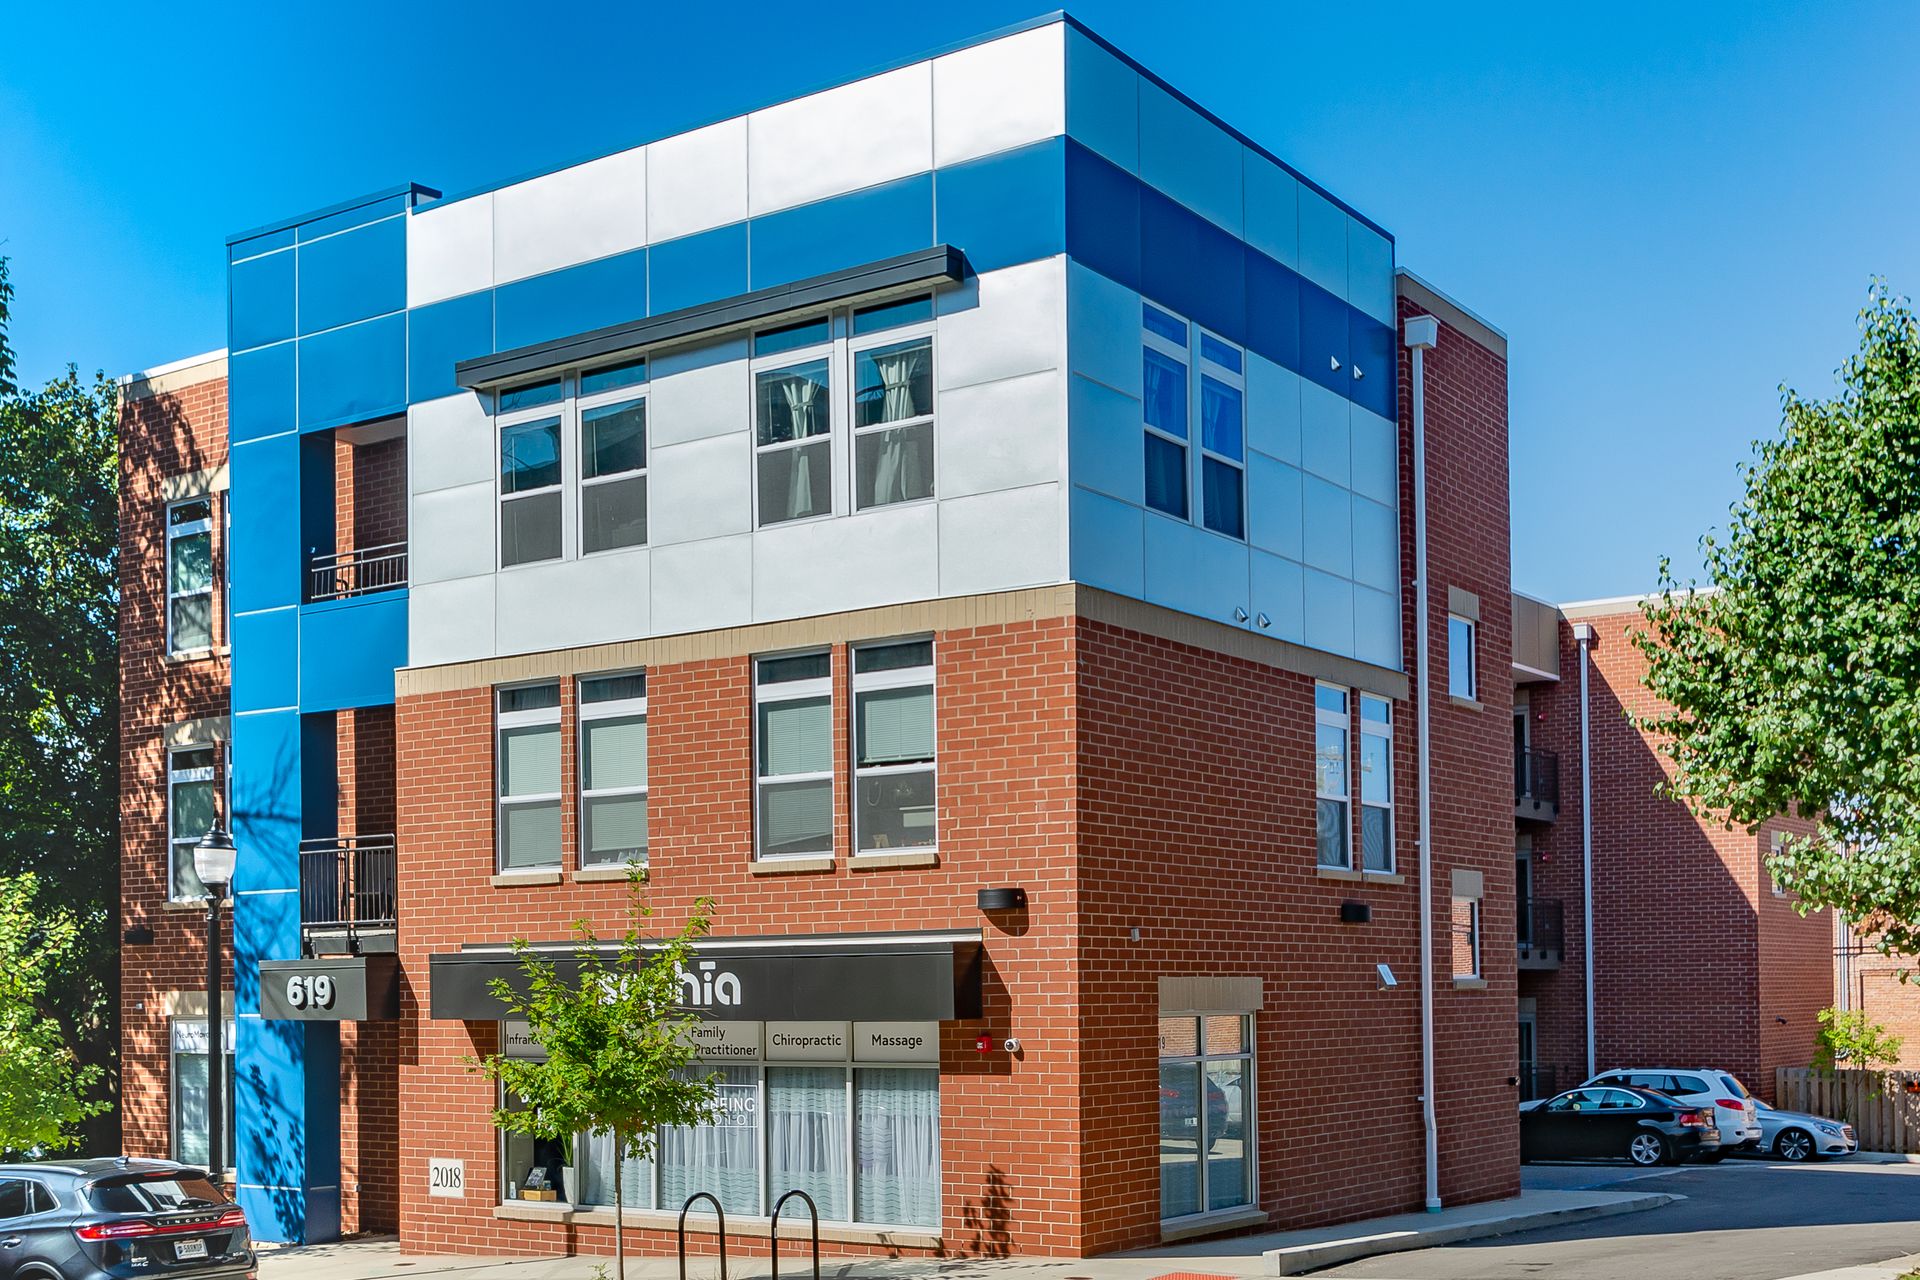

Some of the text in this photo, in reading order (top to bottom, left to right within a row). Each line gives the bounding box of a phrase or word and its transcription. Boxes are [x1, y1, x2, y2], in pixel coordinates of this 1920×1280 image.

[287, 975, 332, 1006] 619
[691, 1026, 726, 1040] Family
[772, 1034, 842, 1048] Chiropractic
[871, 1034, 923, 1049] Massage
[694, 1044, 757, 1056] Practitioner
[432, 1166, 462, 1188] 2018
[157, 1216, 218, 1226] LINCOLN
